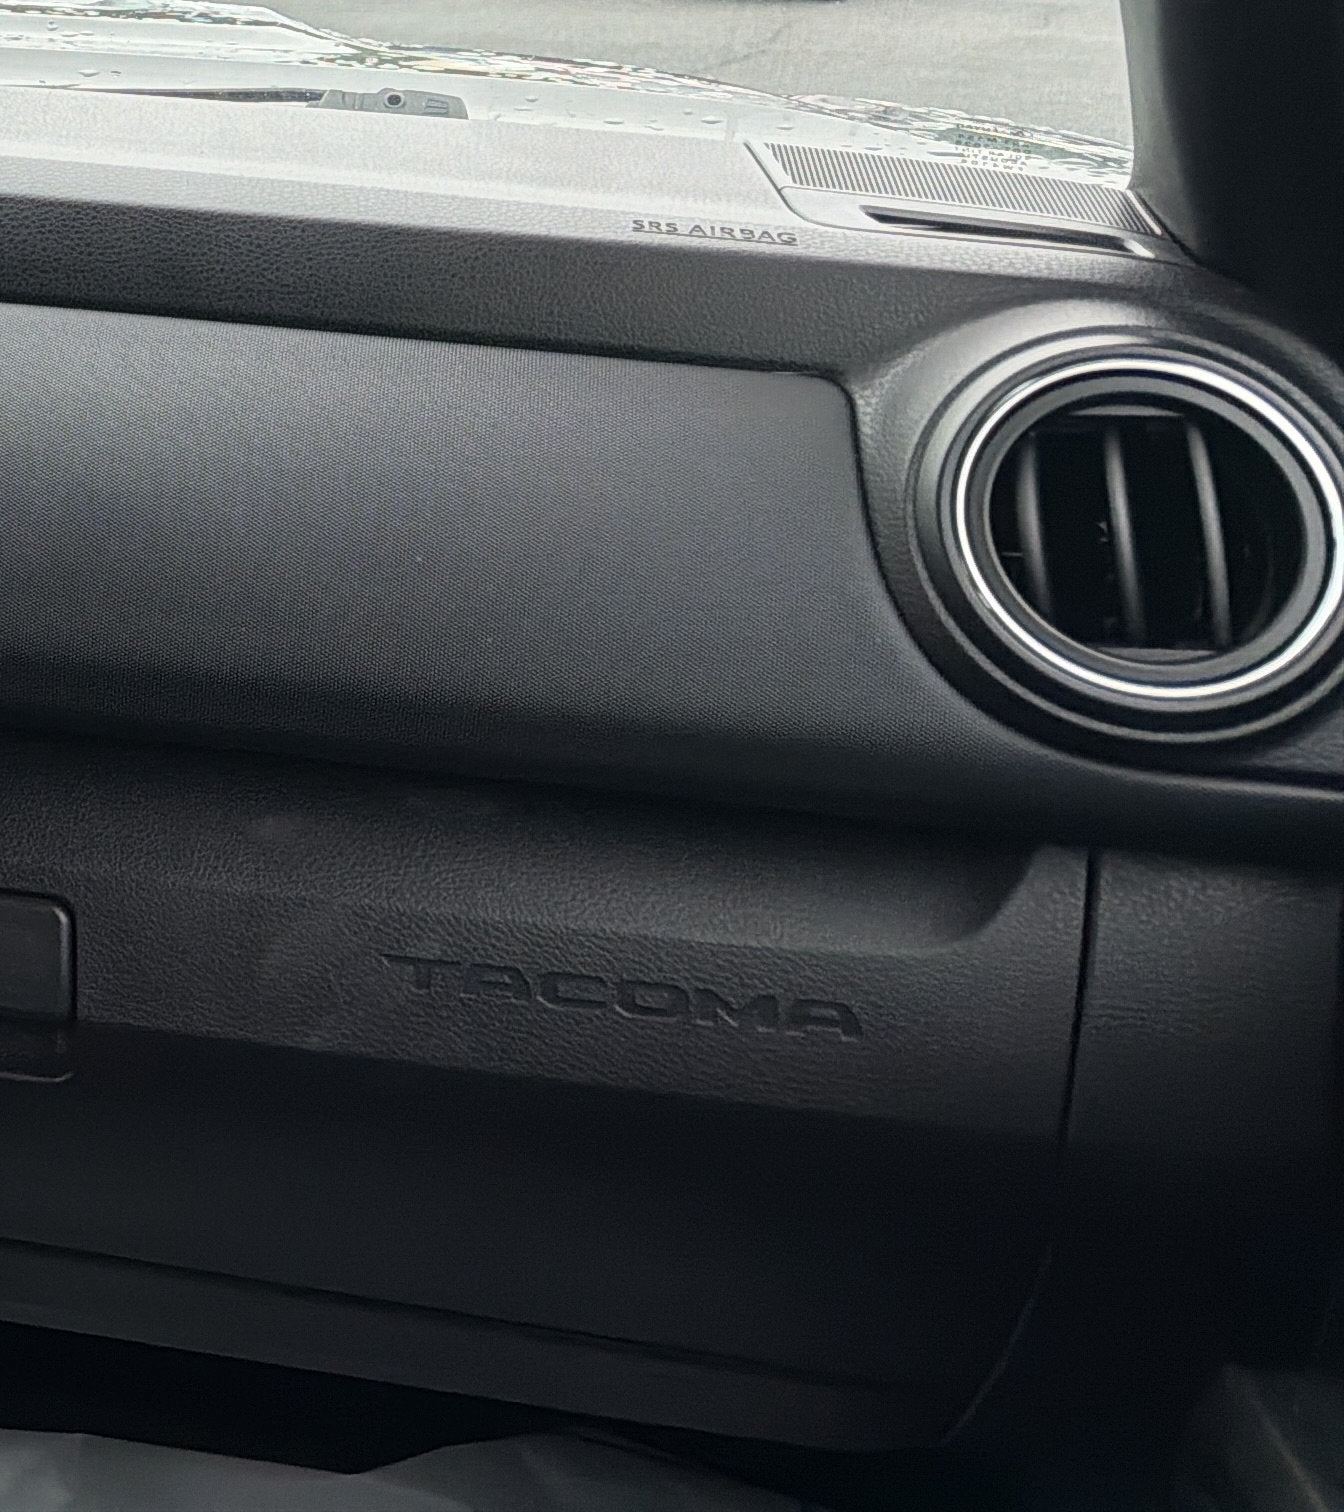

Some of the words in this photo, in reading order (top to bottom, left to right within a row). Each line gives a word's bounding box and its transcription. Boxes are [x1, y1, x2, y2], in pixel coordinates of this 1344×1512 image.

[631, 219, 683, 236] SRS
[688, 224, 799, 246] AIRBAG
[378, 951, 864, 1040] TACOMA
